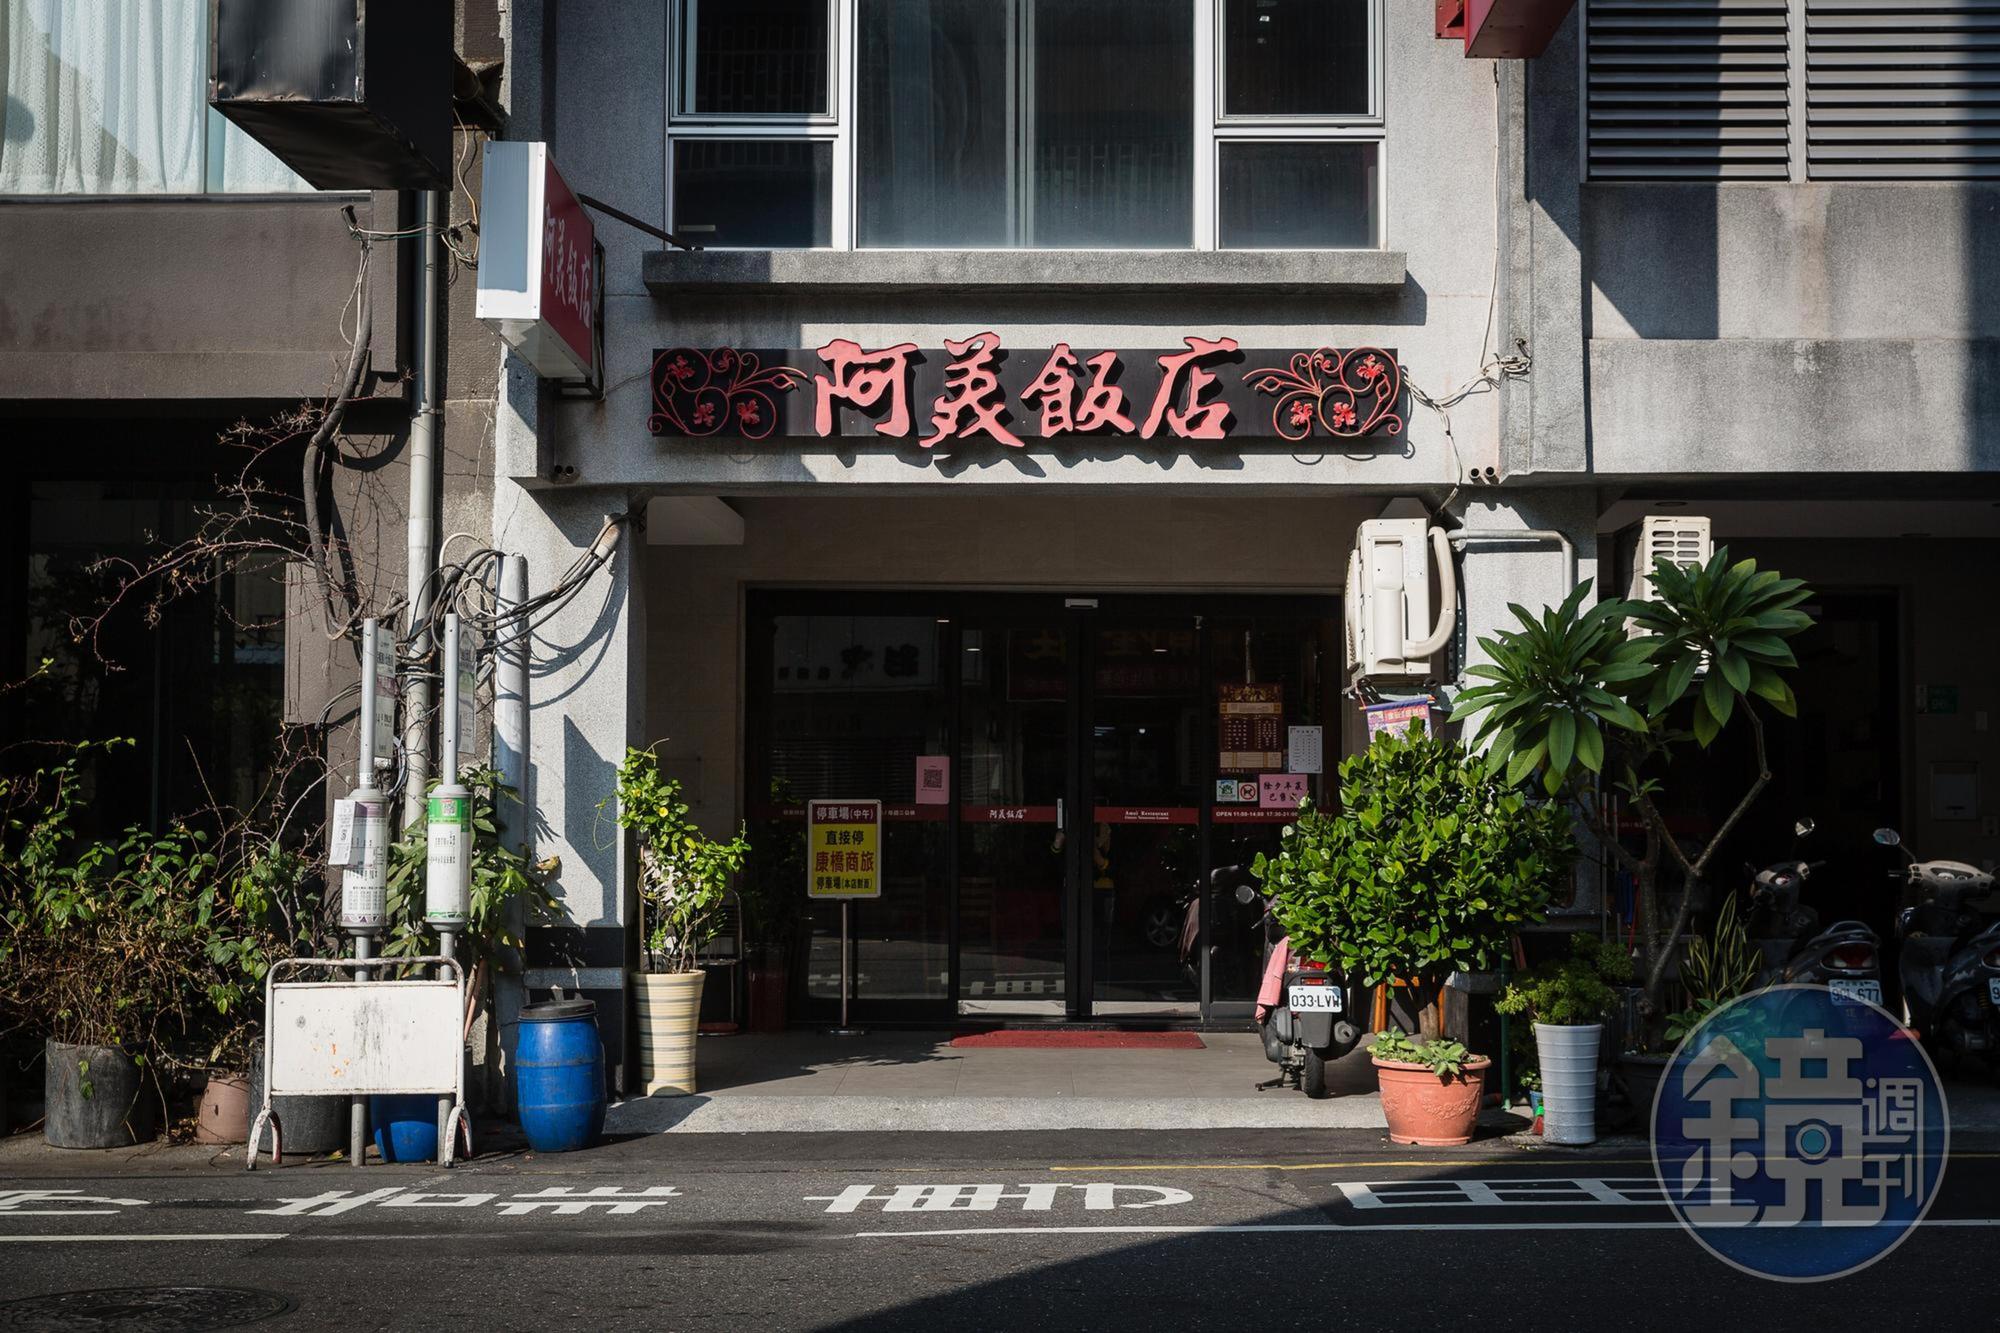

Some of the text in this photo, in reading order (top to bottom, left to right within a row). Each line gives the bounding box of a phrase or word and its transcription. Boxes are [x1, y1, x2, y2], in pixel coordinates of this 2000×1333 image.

[813, 330, 1242, 448] 阿美飯店
[825, 830, 865, 846] 直接停
[815, 850, 874, 873] 康橋商旅
